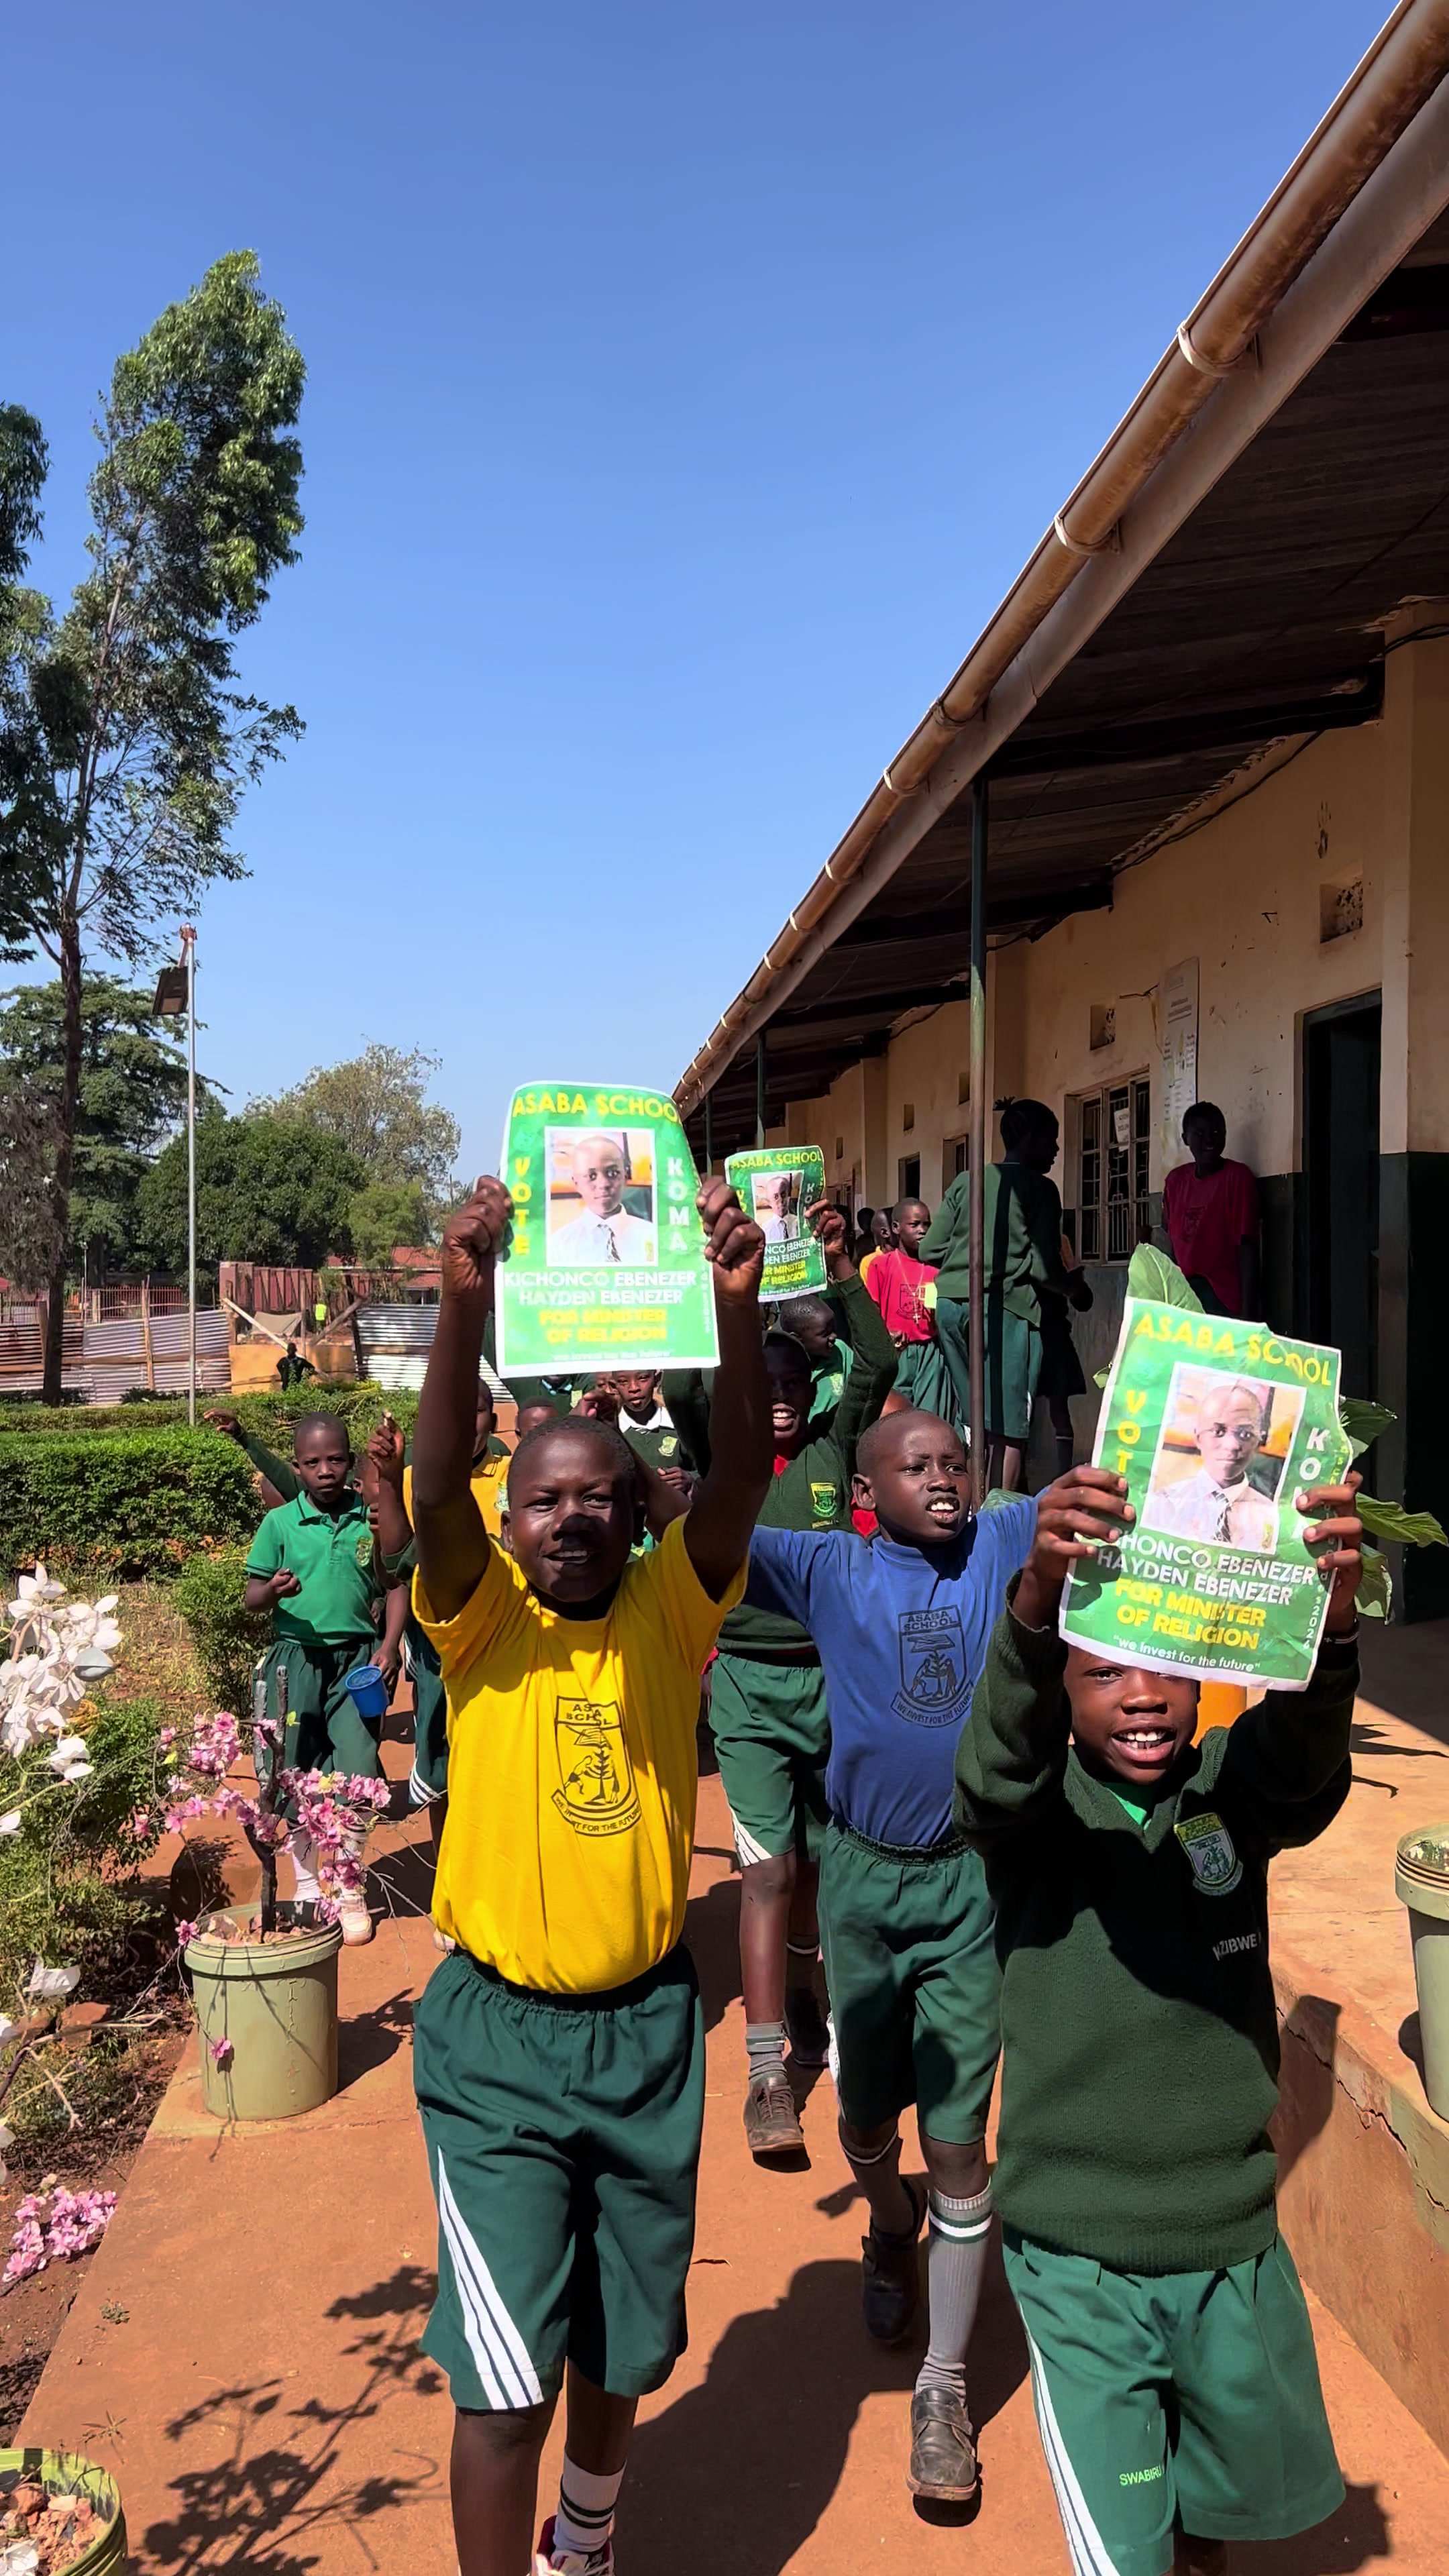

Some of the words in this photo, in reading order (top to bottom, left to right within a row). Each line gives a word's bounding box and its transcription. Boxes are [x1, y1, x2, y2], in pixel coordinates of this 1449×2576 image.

[513, 1091, 589, 1118] ASABA
[594, 1093, 682, 1124] SCHOO
[731, 1155, 773, 1169] ASABA
[776, 1151, 822, 1165] SCHOOL
[511, 1157, 532, 1256] VOTE
[666, 1157, 690, 1251] KOMA
[614, 1271, 696, 1287] EBENEZER
[519, 1290, 596, 1305] HAYDEN
[600, 1289, 683, 1305] EBENEZER
[539, 1309, 578, 1326] FOR
[547, 1328, 573, 1344] OF
[577, 1326, 666, 1343] RELIGION
[1134, 1313, 1234, 1356] ASABA
[1247, 1334, 1331, 1385] SCOOL
[1116, 1390, 1147, 1473] VOT
[1120, 1531, 1212, 1568] HONCO
[1217, 1554, 1317, 1585] EBENEZER
[1097, 1550, 1189, 1587] HAYDEN
[1194, 1571, 1292, 1605] EBENEZER
[1115, 1578, 1163, 1607] FOR
[904, 1617, 957, 1631] SCHOOL
[908, 1611, 949, 1623] ASABA
[1117, 1605, 1150, 1627] OF
[1152, 1613, 1260, 1650] RELIGION
[1140, 1642, 1177, 1660] invest
[1179, 1651, 1195, 1665] for
[1198, 1655, 1216, 1667] the
[1219, 1657, 1261, 1672] future"
[582, 1824, 600, 1832] FOR
[601, 1822, 618, 1831] THE
